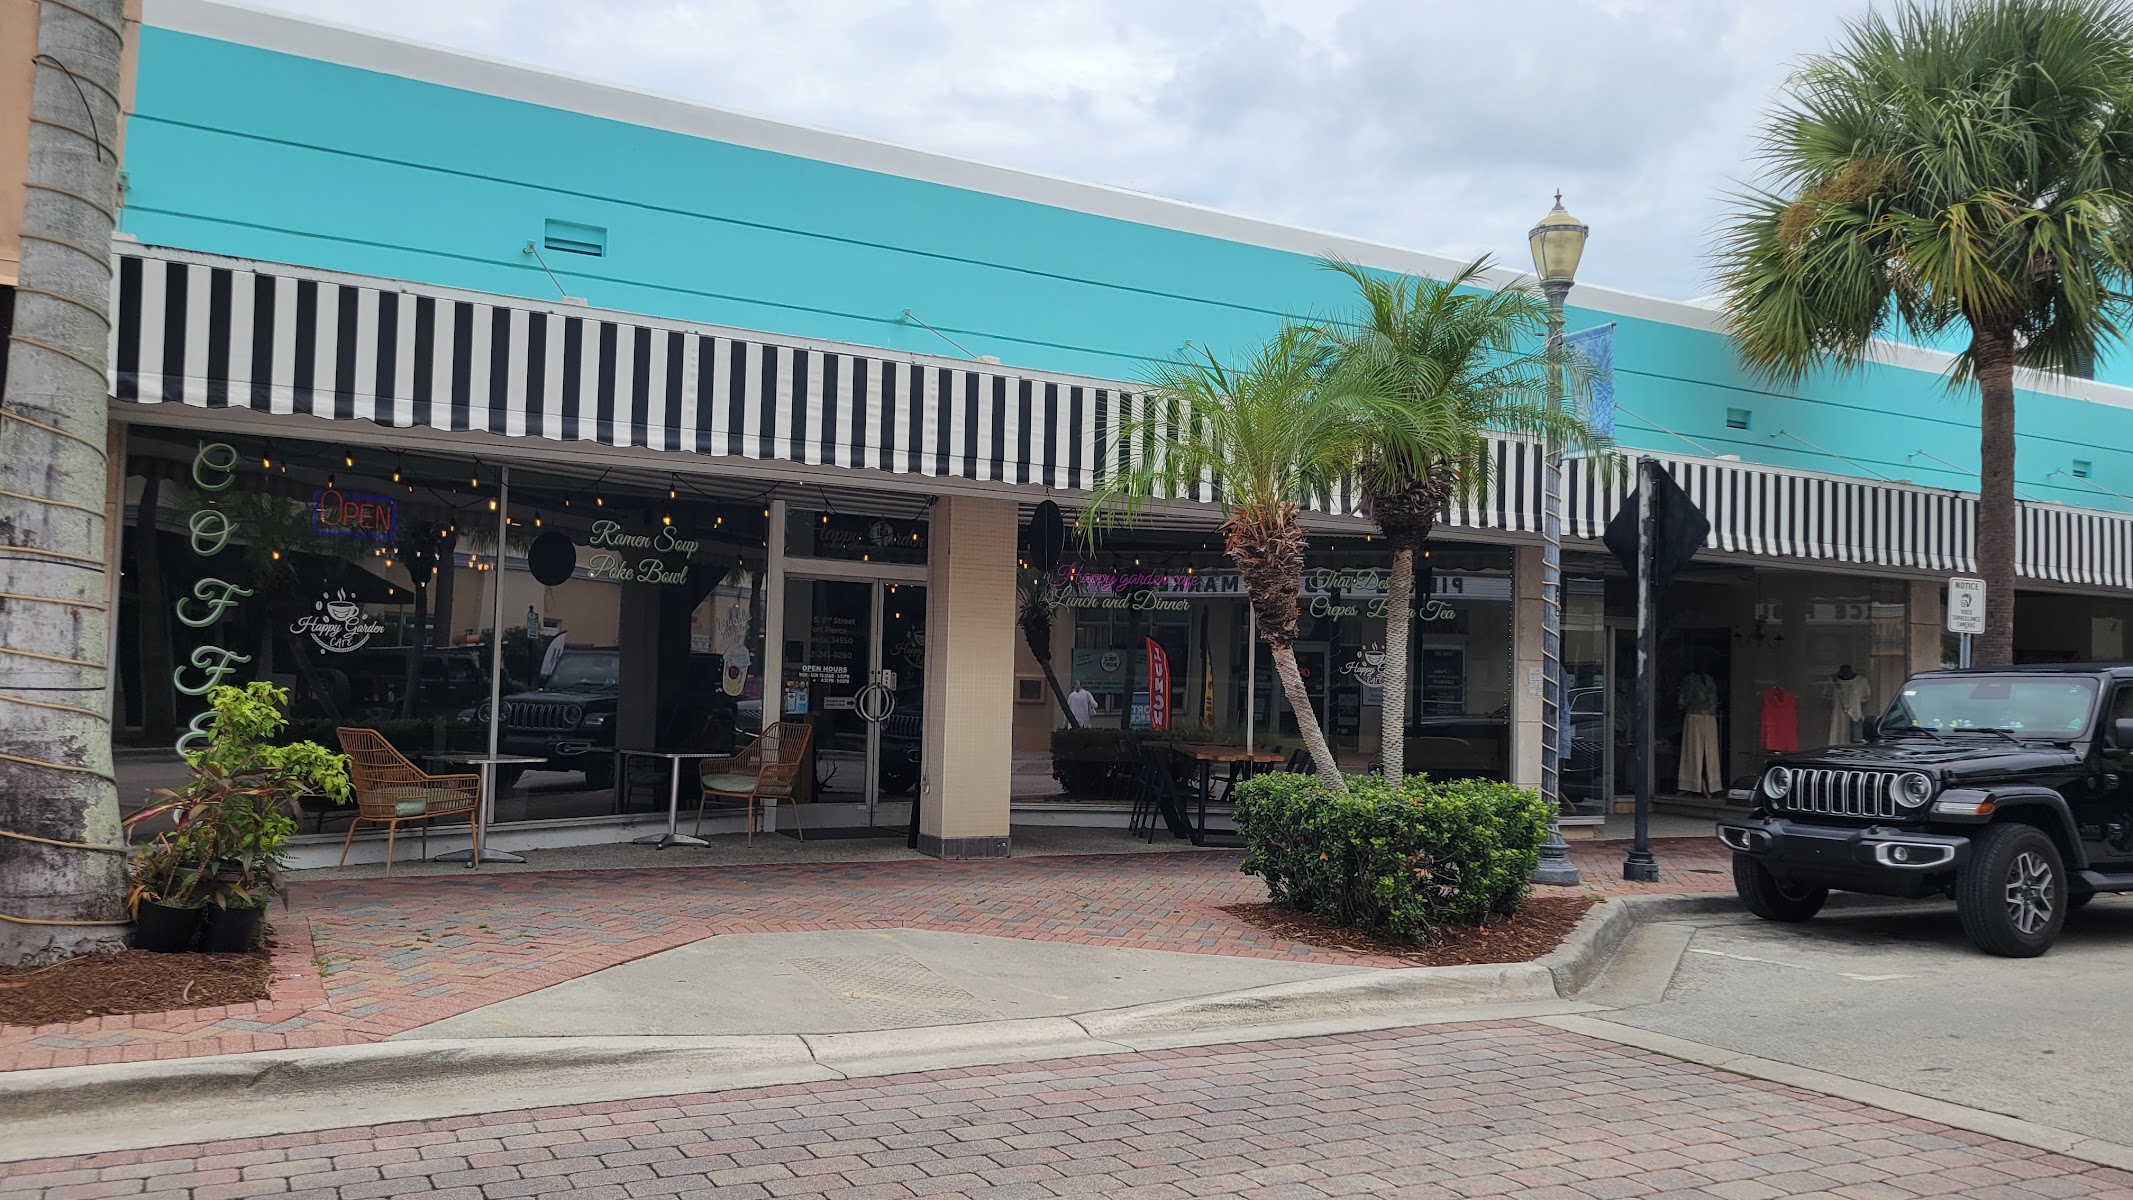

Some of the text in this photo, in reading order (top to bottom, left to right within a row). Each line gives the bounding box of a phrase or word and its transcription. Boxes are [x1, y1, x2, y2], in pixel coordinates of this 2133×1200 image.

[320, 490, 392, 531] OPEN
[590, 520, 699, 560] Ramen Soup
[588, 555, 689, 585] Poke Bowl
[1049, 562, 1117, 592] Happy
[1115, 568, 1169, 592] garden
[1309, 568, 1351, 589] Thai
[1049, 585, 1191, 613] Lunch and Dinner
[1955, 582, 1979, 590] NOTICE
[1309, 596, 1358, 622] Crepes
[1419, 600, 1457, 621] Tea
[290, 615, 385, 639] Happy Garden
[801, 664, 848, 673] OPEN HOURS
[1339, 661, 1376, 677] Happy
